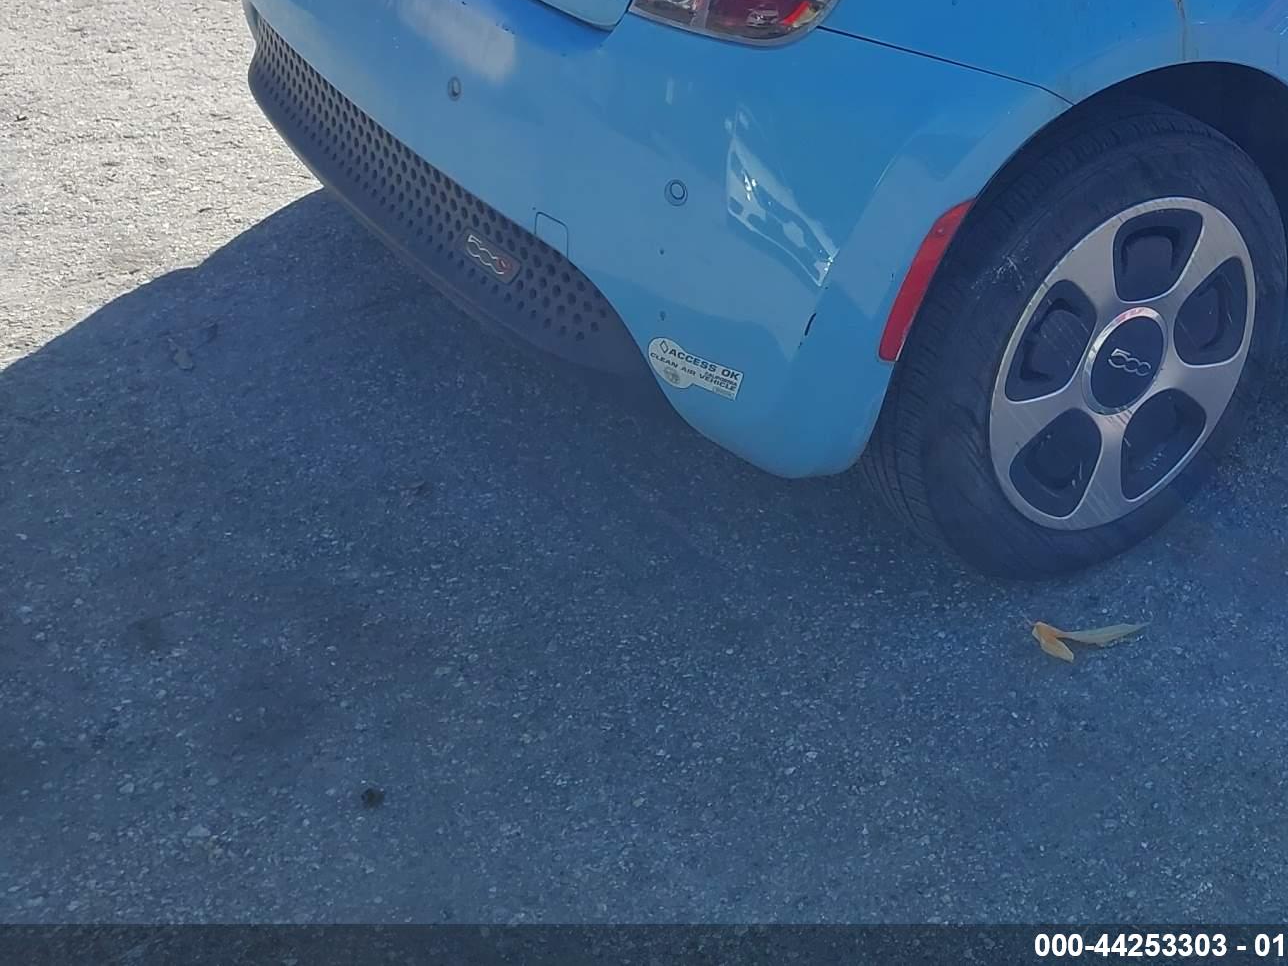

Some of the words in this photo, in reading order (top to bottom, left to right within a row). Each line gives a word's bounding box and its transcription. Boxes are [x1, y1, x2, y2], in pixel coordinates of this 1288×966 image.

[649, 352, 679, 369] CLEAN
[681, 366, 697, 376] AIR
[699, 374, 737, 391] VEHICLE
[668, 348, 718, 372] ACCESS
[721, 369, 740, 381] OK
[1108, 348, 1152, 377] 500
